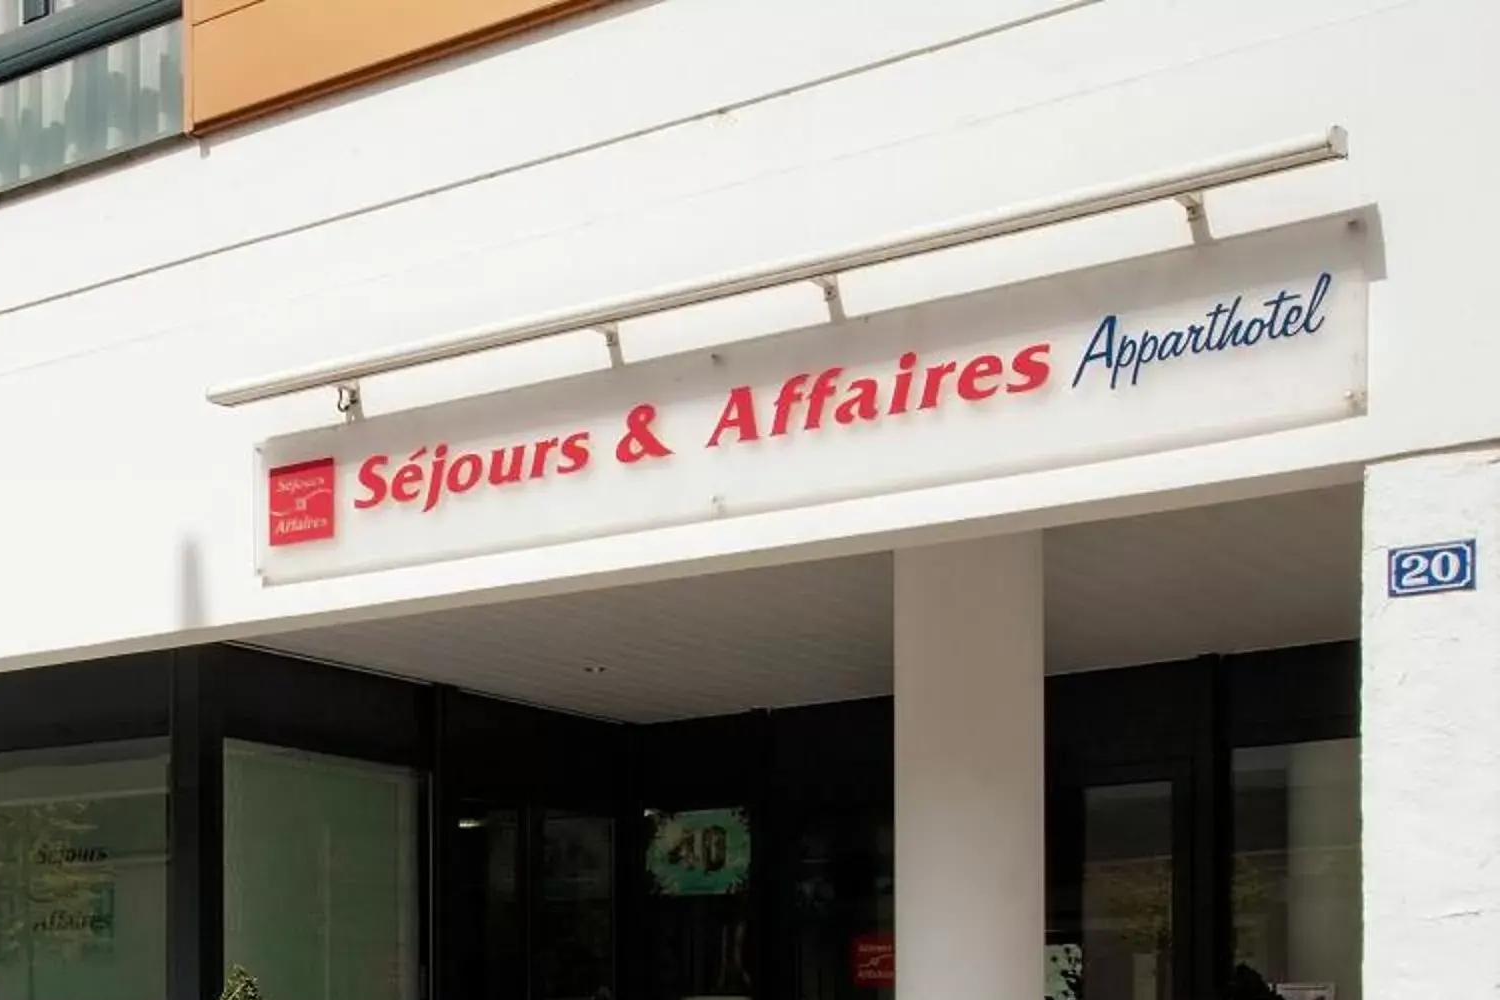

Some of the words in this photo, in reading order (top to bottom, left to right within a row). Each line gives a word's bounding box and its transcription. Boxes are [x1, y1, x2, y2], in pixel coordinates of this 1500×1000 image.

[354, 430, 591, 513] Séjours
[615, 402, 675, 463] &
[704, 342, 1051, 448] Affaires
[1072, 272, 1333, 389] Apparthotel
[1401, 551, 1460, 586] 20
